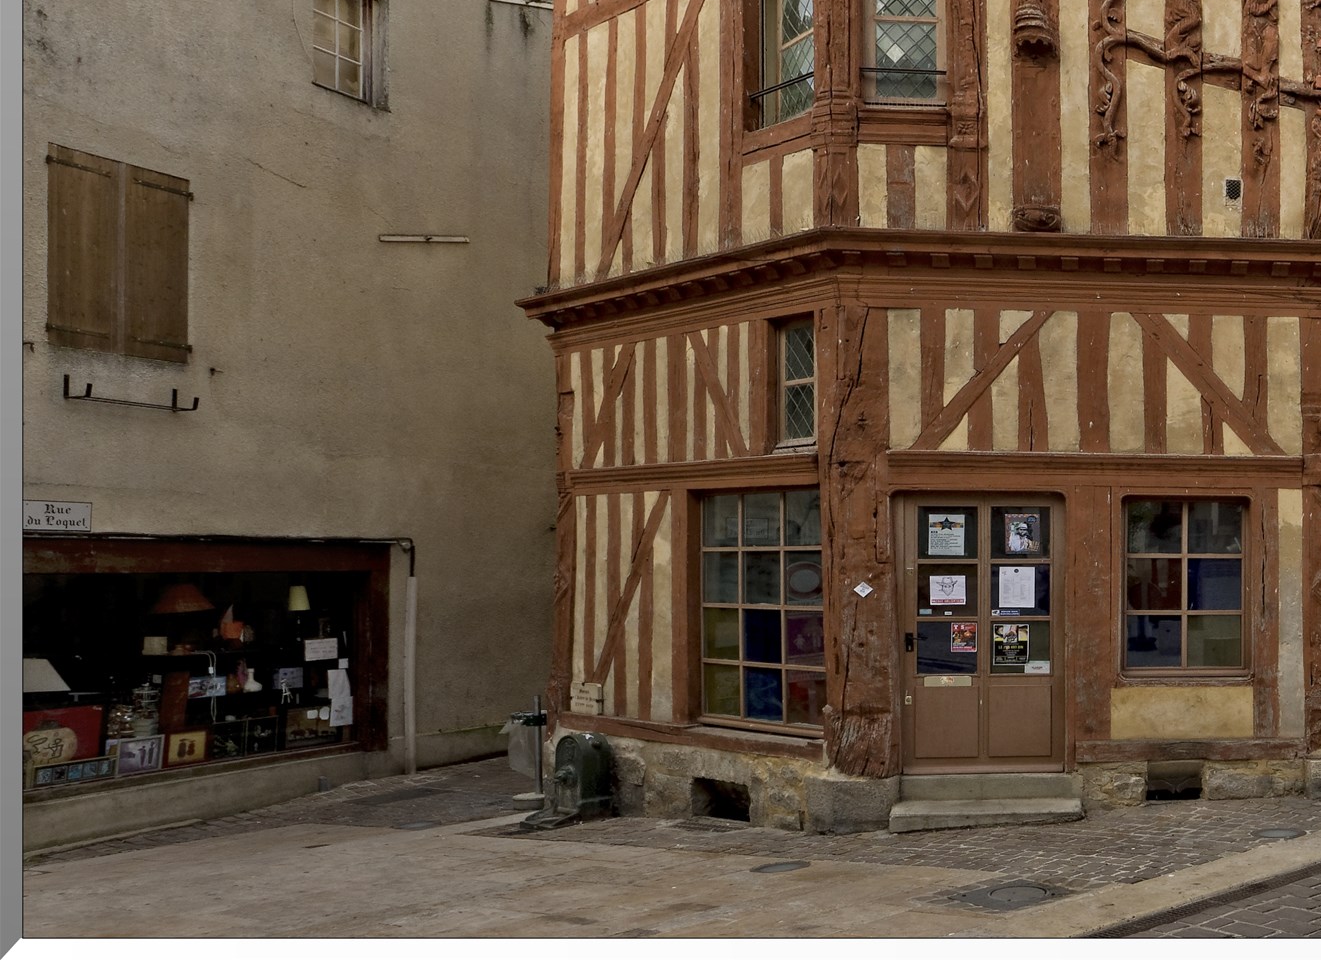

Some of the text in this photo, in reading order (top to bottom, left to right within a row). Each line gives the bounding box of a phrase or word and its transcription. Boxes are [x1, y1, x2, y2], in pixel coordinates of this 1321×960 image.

[44, 503, 72, 514] Rue
[27, 515, 86, 529] du Loquet
